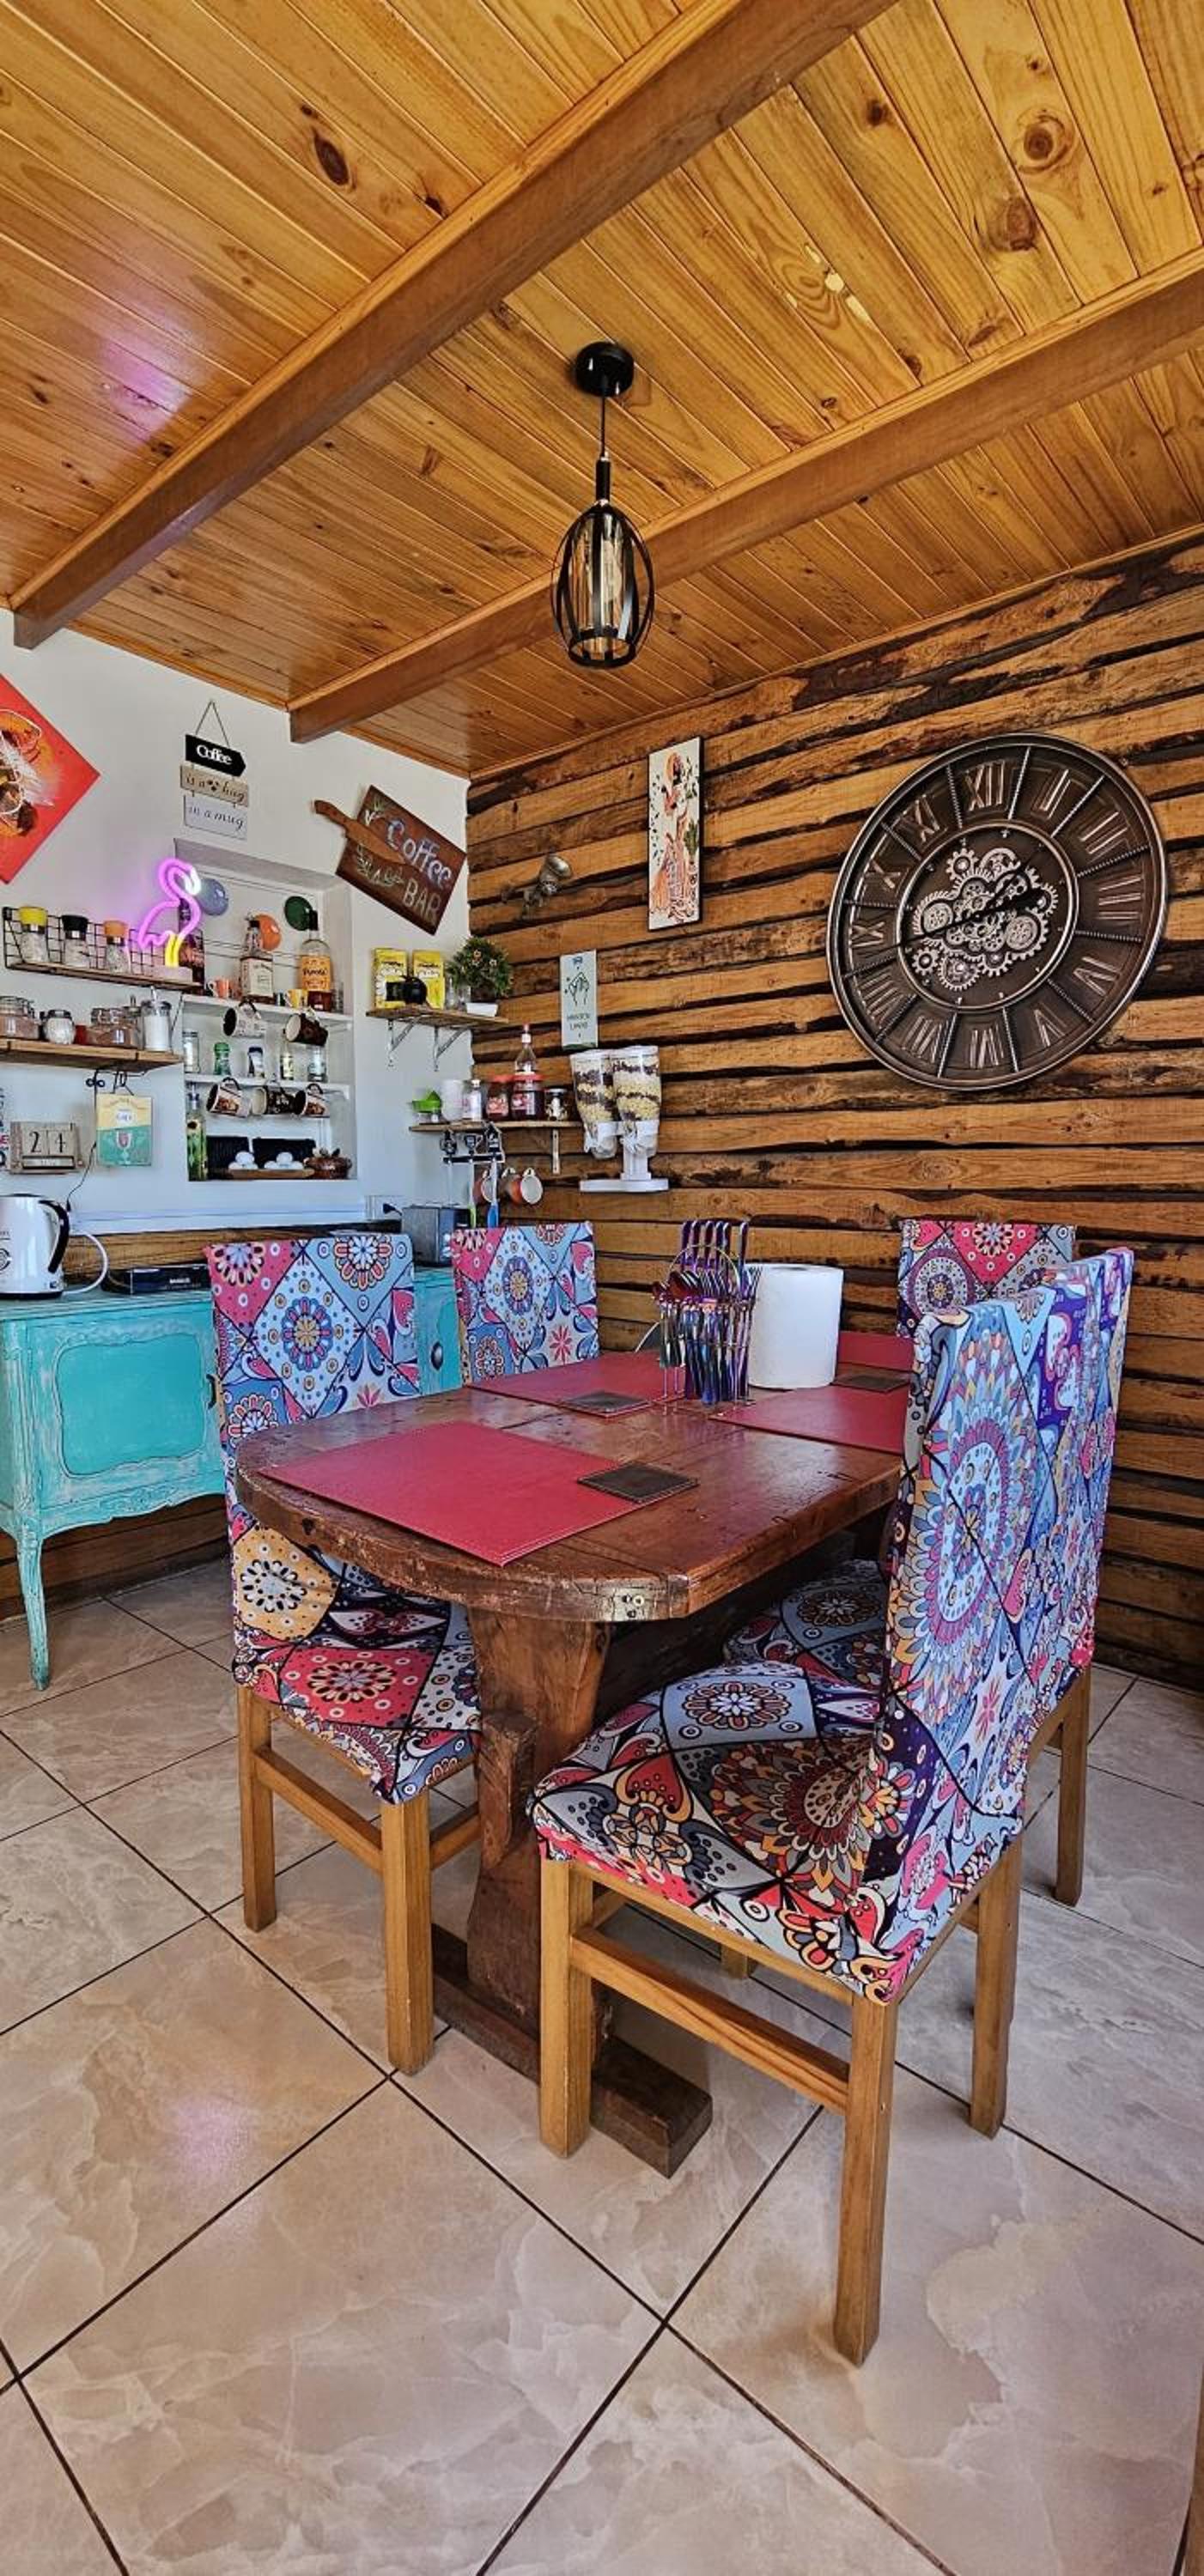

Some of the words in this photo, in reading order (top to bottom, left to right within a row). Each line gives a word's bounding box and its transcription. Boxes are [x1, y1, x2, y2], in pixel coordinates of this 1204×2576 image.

[196, 744, 233, 766] Coffee
[964, 759, 1007, 811] XII
[204, 810, 211, 818] a
[214, 812, 244, 831] mug
[902, 793, 940, 843] XI
[387, 819, 452, 887] Coffee
[402, 878, 442, 920] BAR
[1098, 872, 1142, 920] III
